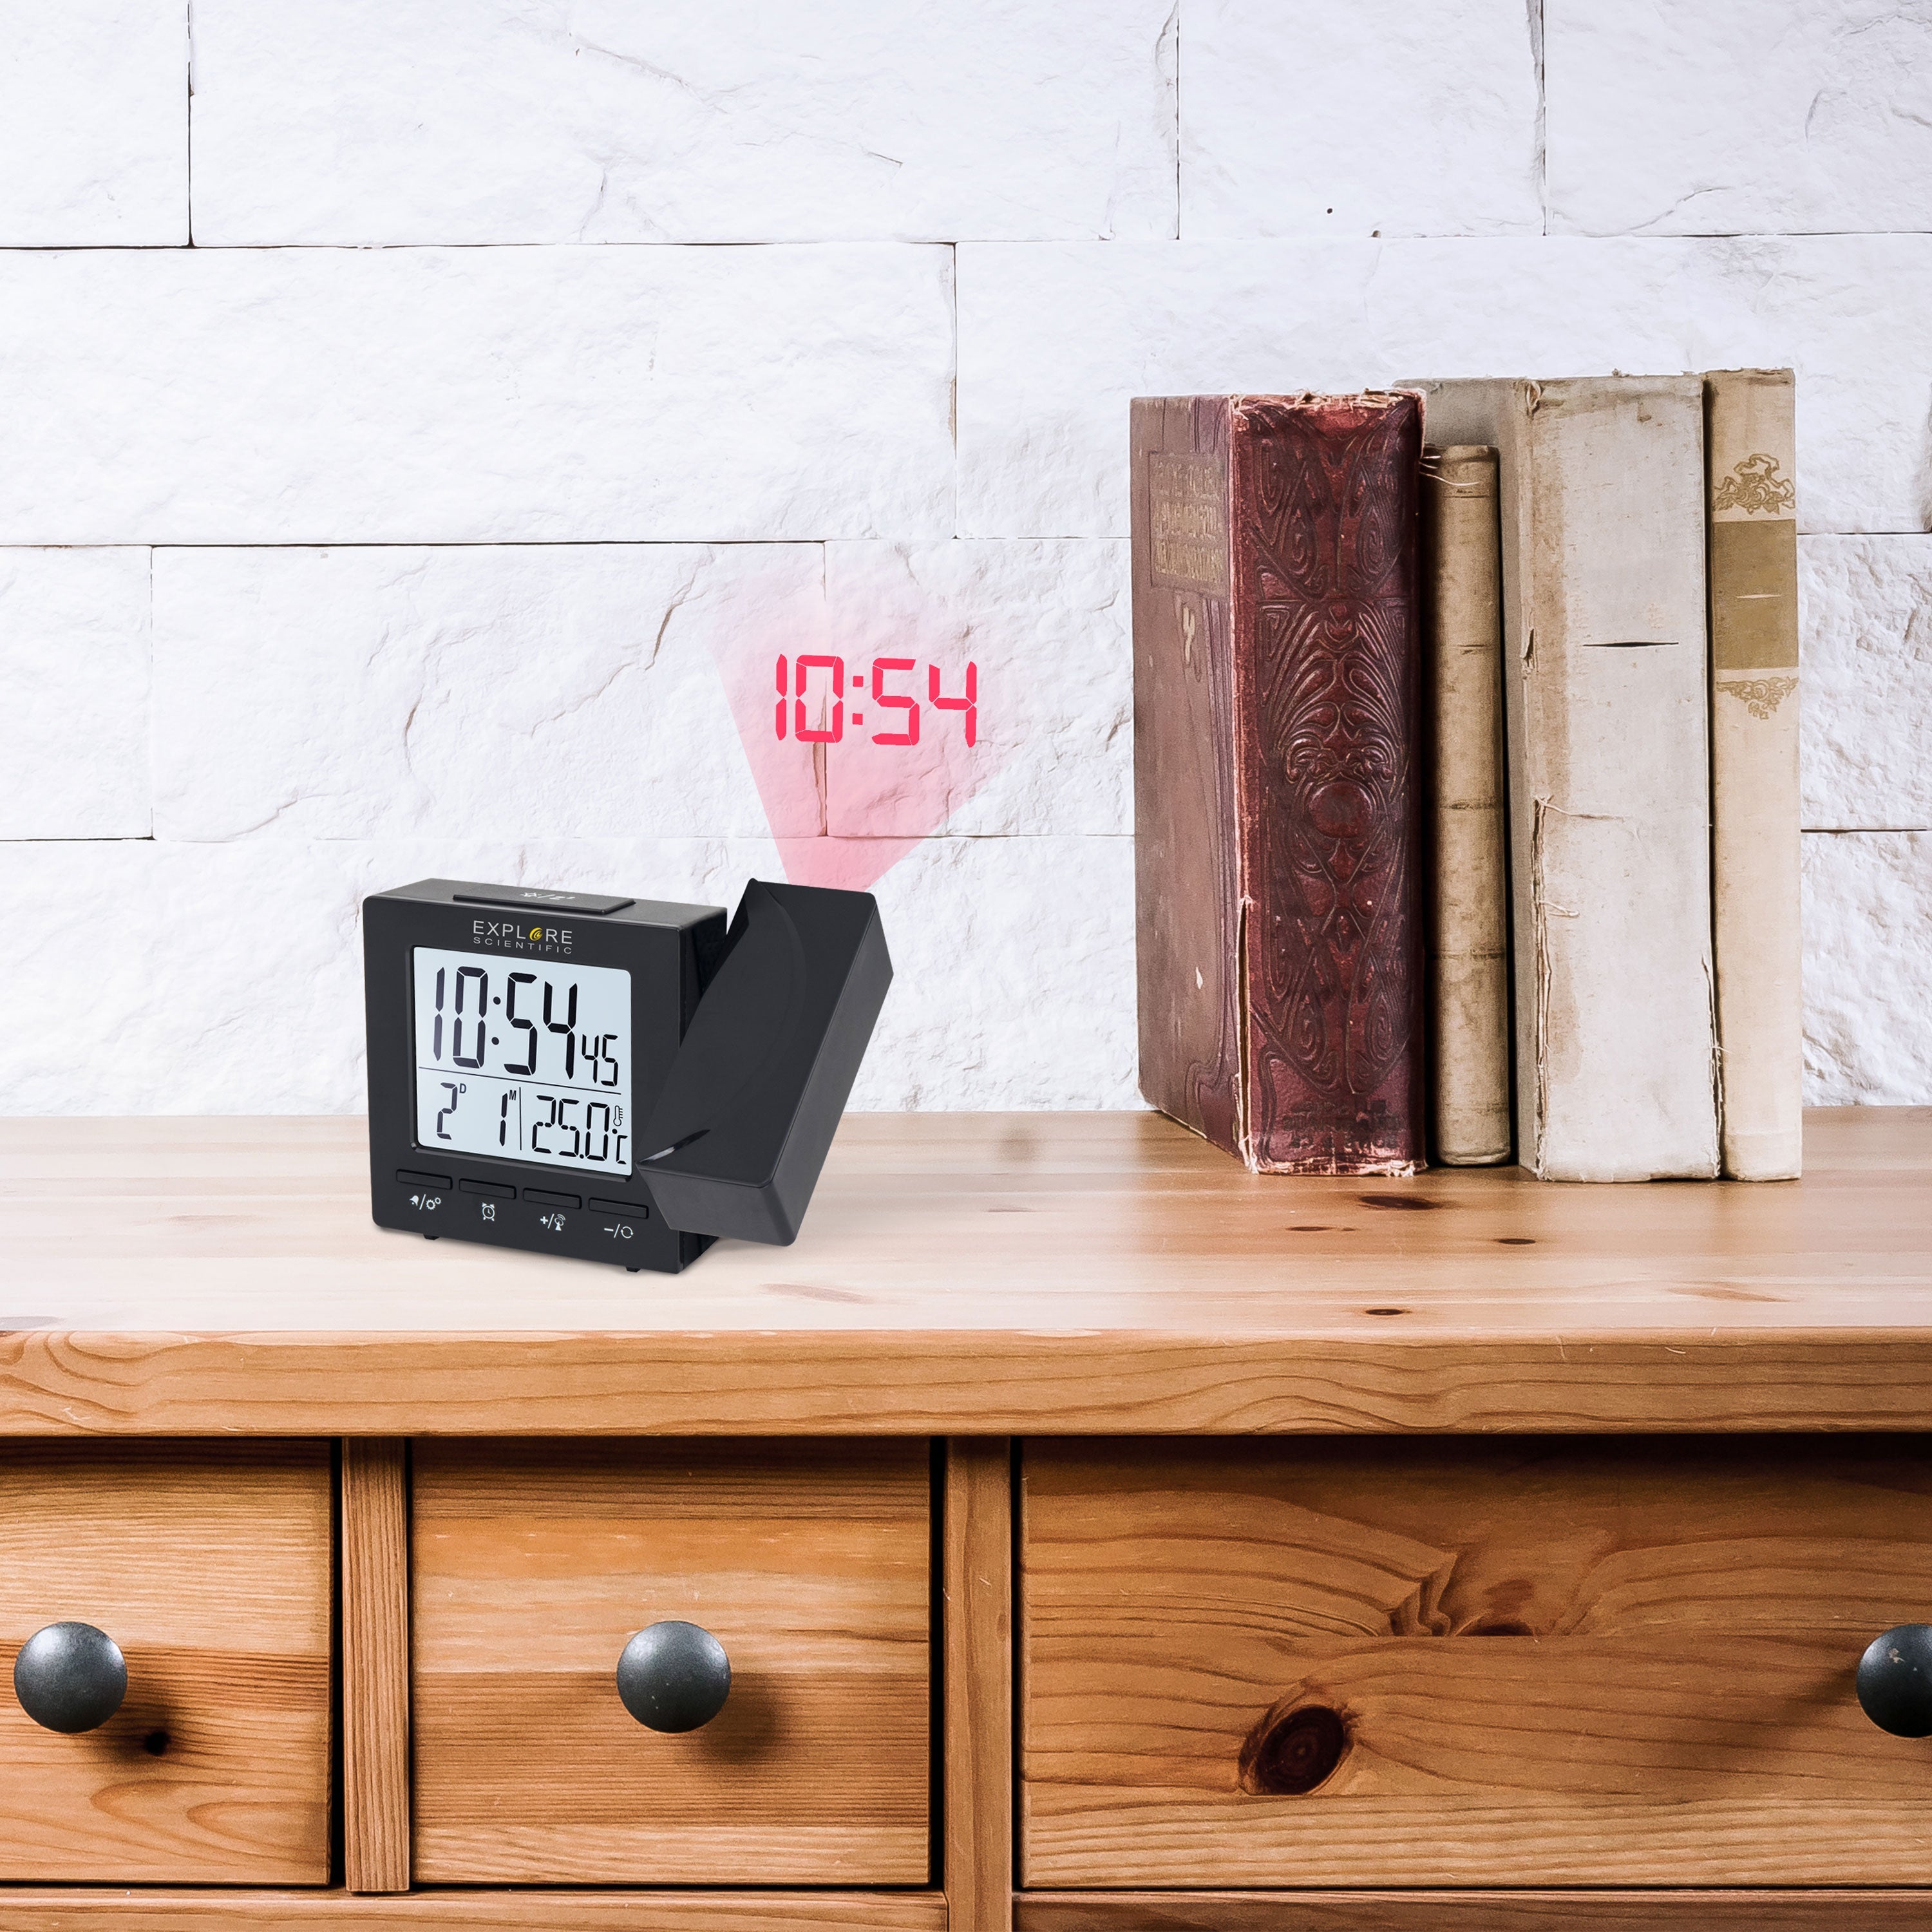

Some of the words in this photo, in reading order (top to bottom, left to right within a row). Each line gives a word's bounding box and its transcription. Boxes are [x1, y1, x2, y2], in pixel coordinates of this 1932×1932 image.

[775, 653, 978, 748] 10:54
[473, 920, 573, 945] EXPLORE
[473, 936, 573, 954] SCIENTIFIC
[433, 965, 578, 1081] 10:54
[581, 1033, 619, 1087] 45
